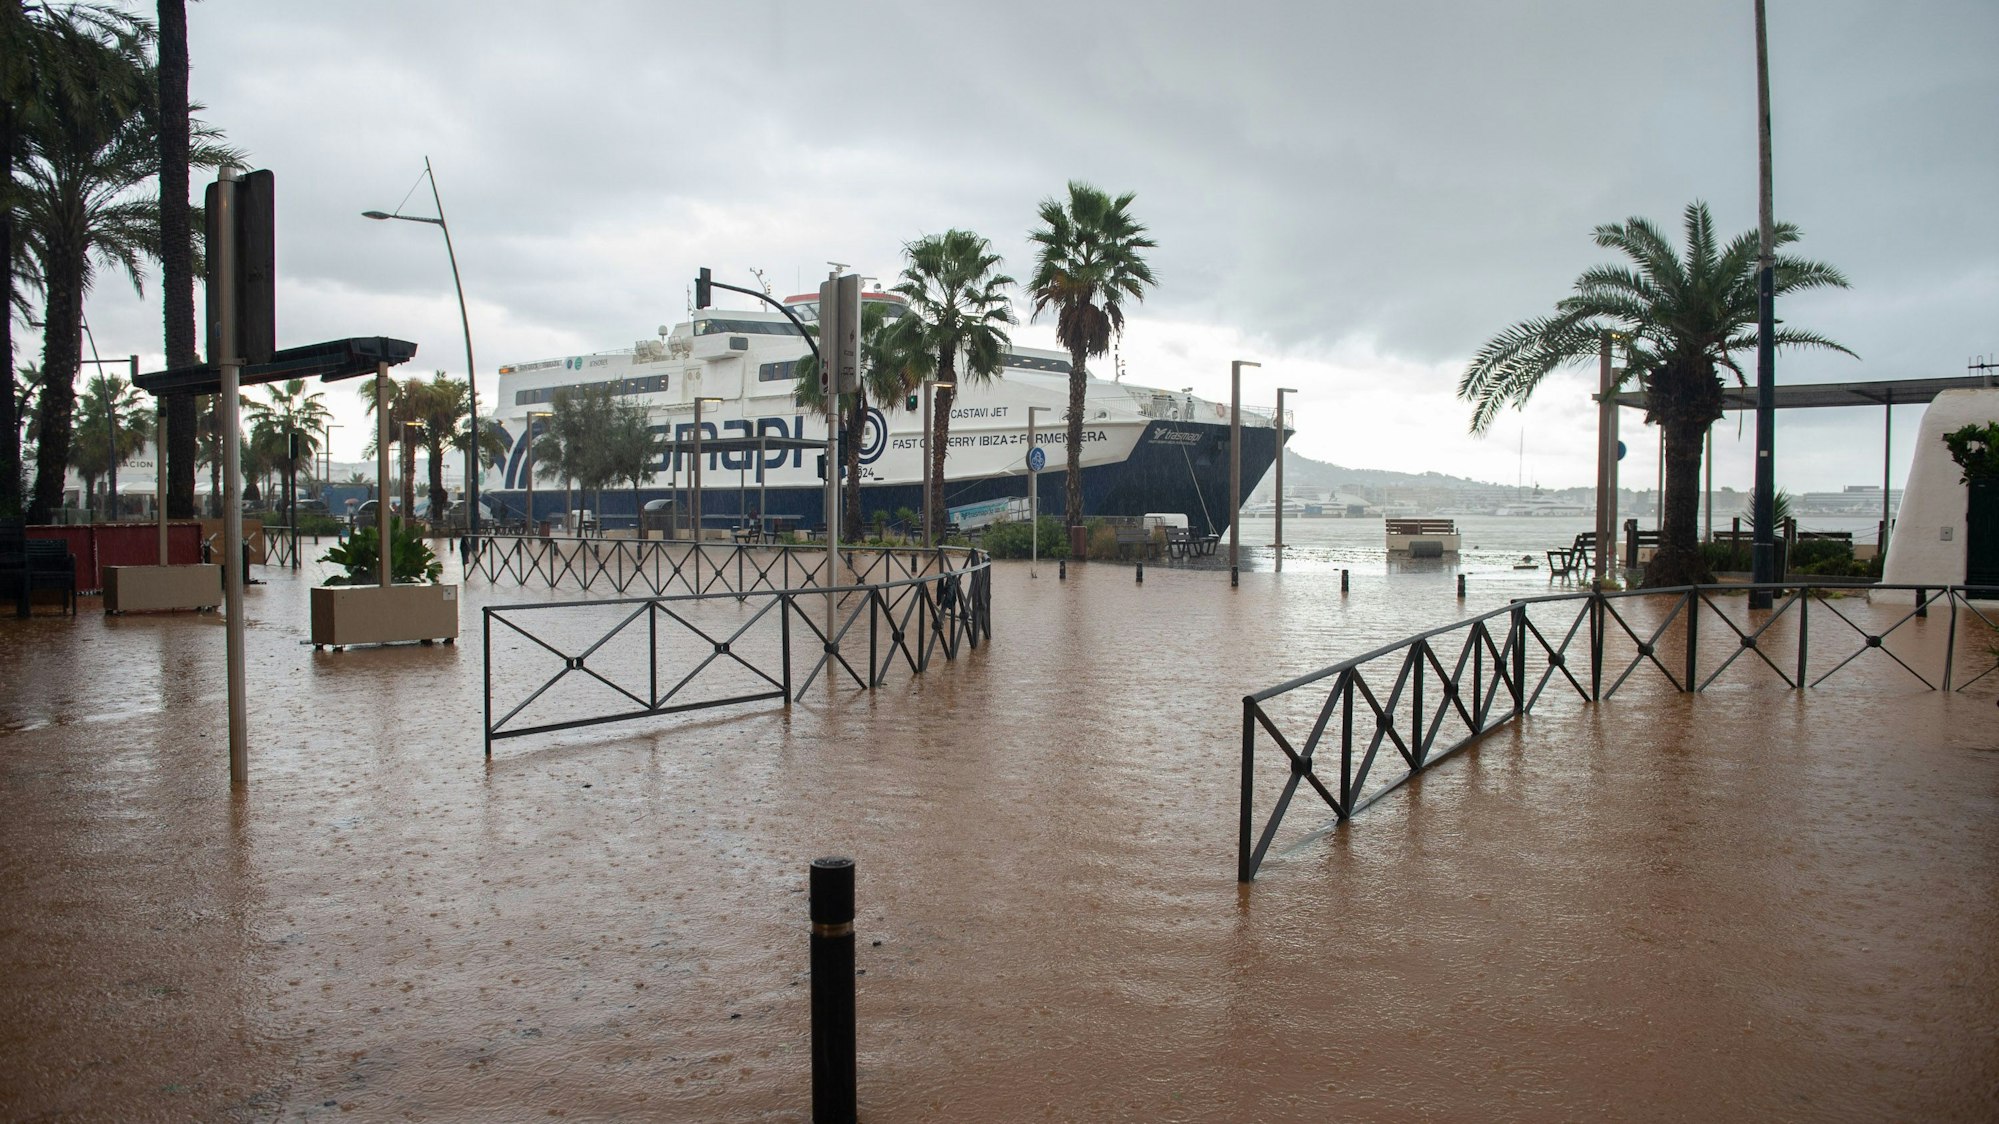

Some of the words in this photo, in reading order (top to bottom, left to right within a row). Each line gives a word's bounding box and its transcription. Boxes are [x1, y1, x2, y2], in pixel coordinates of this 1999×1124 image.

[950, 408, 988, 418] CASTAVI
[991, 407, 1008, 417] JET
[892, 439, 918, 449] FAST
[947, 436, 977, 447] ERRY
[979, 435, 1009, 446] IBIZA
[1019, 430, 1108, 445] FRMENERA
[1164, 429, 1205, 443] trasmapi
[121, 460, 154, 468] ACION
